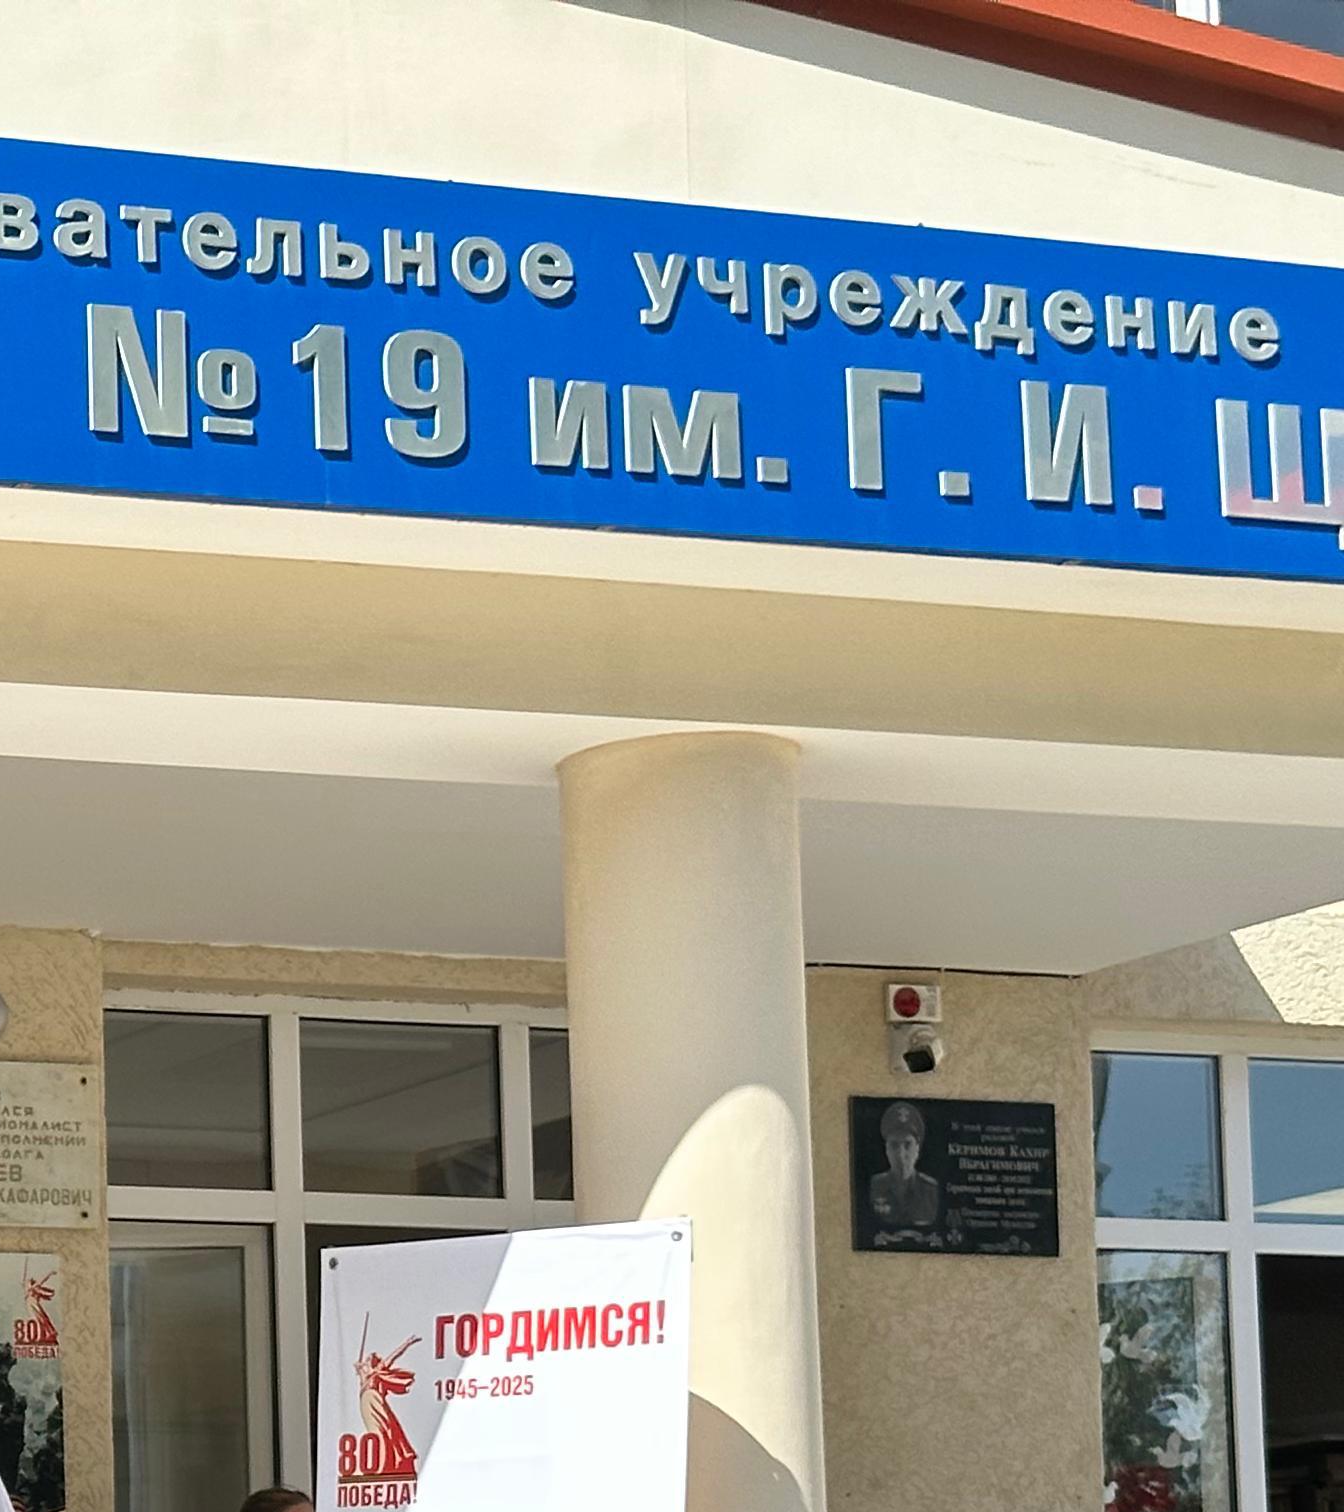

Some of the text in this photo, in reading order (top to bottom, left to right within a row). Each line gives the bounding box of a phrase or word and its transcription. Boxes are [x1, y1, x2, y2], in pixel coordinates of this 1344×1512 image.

[634, 249, 1282, 362] учреждение
[86, 301, 466, 459] №19
[529, 375, 788, 484] им.
[847, 367, 970, 498] Г.
[1020, 380, 1164, 511] И.
[14, 1319, 38, 1342] 80
[434, 1300, 666, 1362] ГОРДИМСЯ!
[338, 1432, 381, 1476] 80
[337, 1482, 418, 1509] ПОБЕДА!
